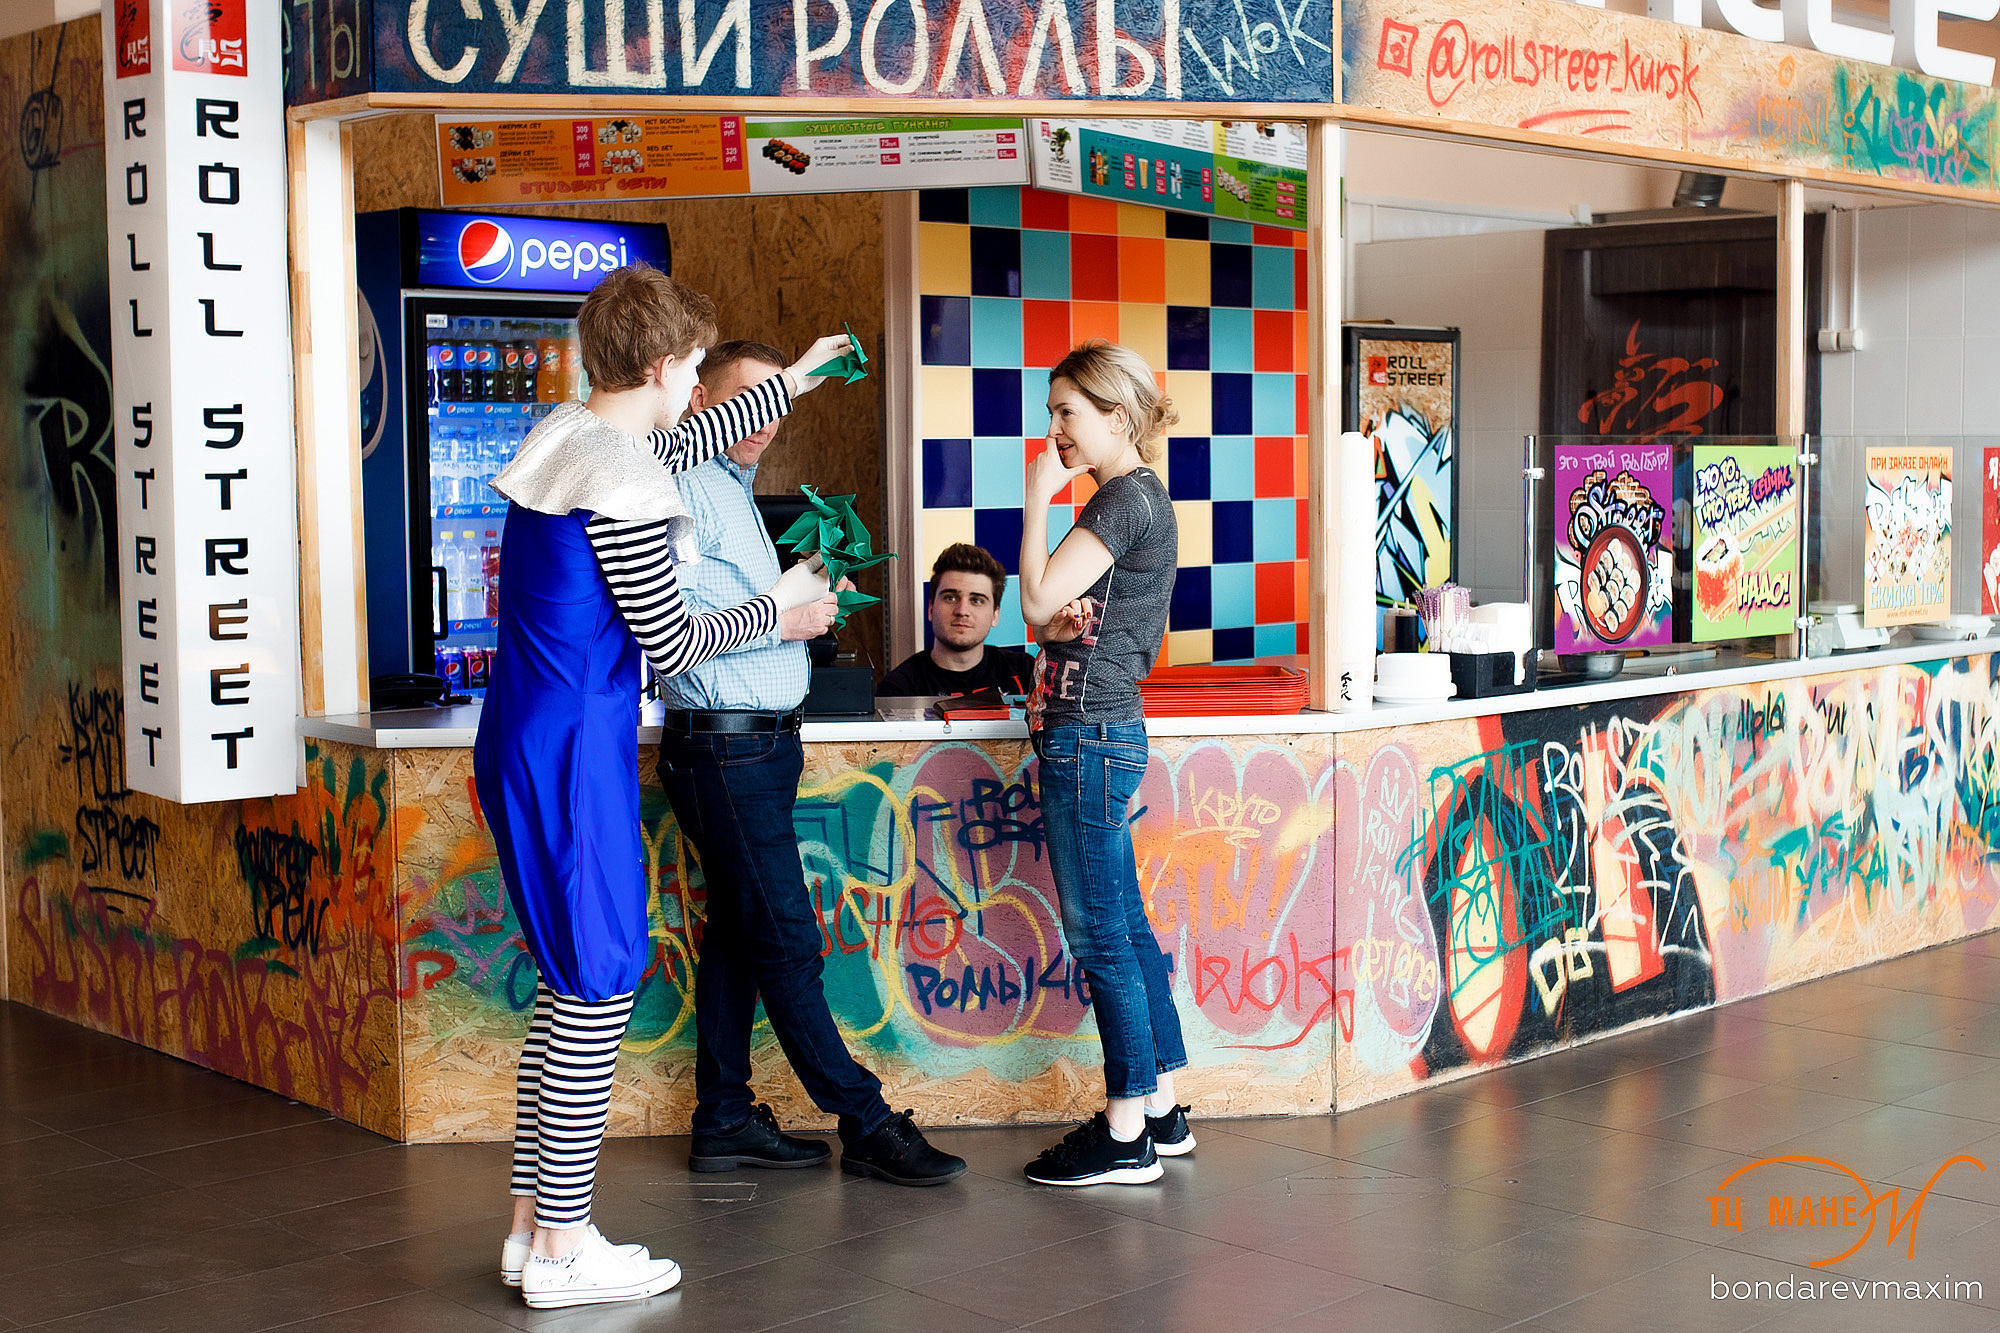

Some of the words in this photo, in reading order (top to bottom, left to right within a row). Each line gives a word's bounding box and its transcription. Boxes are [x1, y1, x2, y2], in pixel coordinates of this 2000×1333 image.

[407, 0, 752, 90] СУШИ
[794, 0, 1182, 99] РОЛЛЫ
[123, 98, 153, 338] ROLL
[196, 98, 244, 338] ROLL
[520, 236, 628, 280] pepsi
[1387, 372, 1447, 387] STREET
[1388, 355, 1427, 370] ROLL
[1870, 457, 1887, 471] ПРИ
[1888, 455, 1917, 470] ЗАКАЗЕ
[1918, 453, 1948, 470] ОНЛАЙН
[132, 402, 163, 768] STREET
[203, 403, 254, 770] STREET
